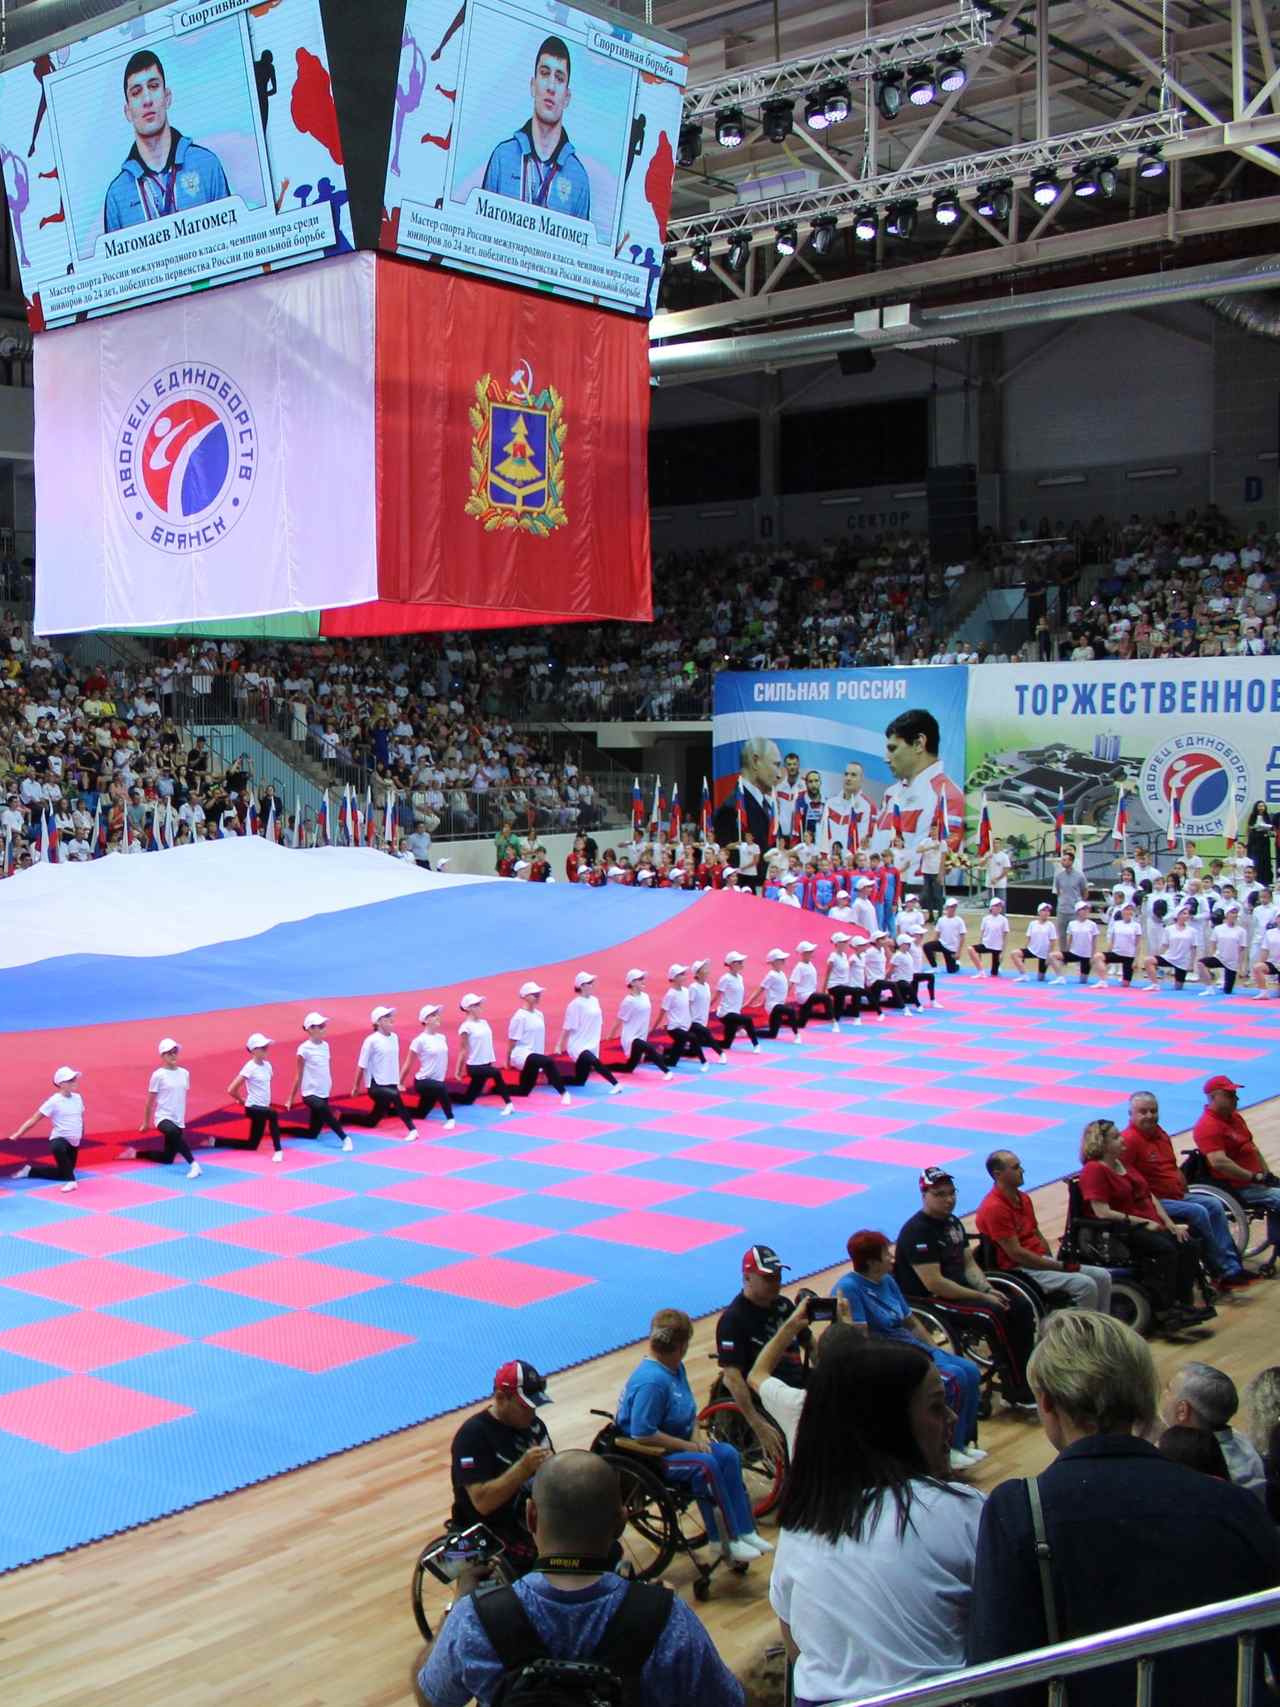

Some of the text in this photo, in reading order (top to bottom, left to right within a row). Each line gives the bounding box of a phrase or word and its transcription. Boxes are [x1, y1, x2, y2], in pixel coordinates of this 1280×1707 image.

[593, 32, 673, 76] Спортивная борьба
[104, 208, 238, 259] Магомаев Магомед
[410, 212, 439, 232] Мастер
[440, 221, 465, 237] спорта
[467, 226, 492, 242] России
[494, 236, 551, 259] международного
[475, 196, 589, 247] Магомаев Магомед
[49, 215, 319, 299] Мастер спорта России международного класса, чемпион мира среди
[83, 294, 93, 305] до
[94, 289, 103, 301] 24
[119, 276, 164, 293] победитель
[165, 262, 210, 281] первенства
[212, 252, 241, 269] России
[243, 249, 254, 261] по
[255, 239, 292, 256] вольной
[294, 228, 326, 247] борьбе
[407, 230, 441, 246] юниоров
[443, 240, 452, 250] до
[453, 239, 462, 251] 24
[463, 244, 477, 257] лет,
[479, 247, 519, 266] победитель
[119, 367, 254, 498] ДВОРЕЦ ЕДИНОБОРСТВ
[150, 516, 227, 549] БРЯНСК
[753, 679, 907, 702] СИЛЬНАЯ РОССИЯ
[1146, 736, 1248, 803] ДВОРЕЦ ЕДИНОБОРСТВ
